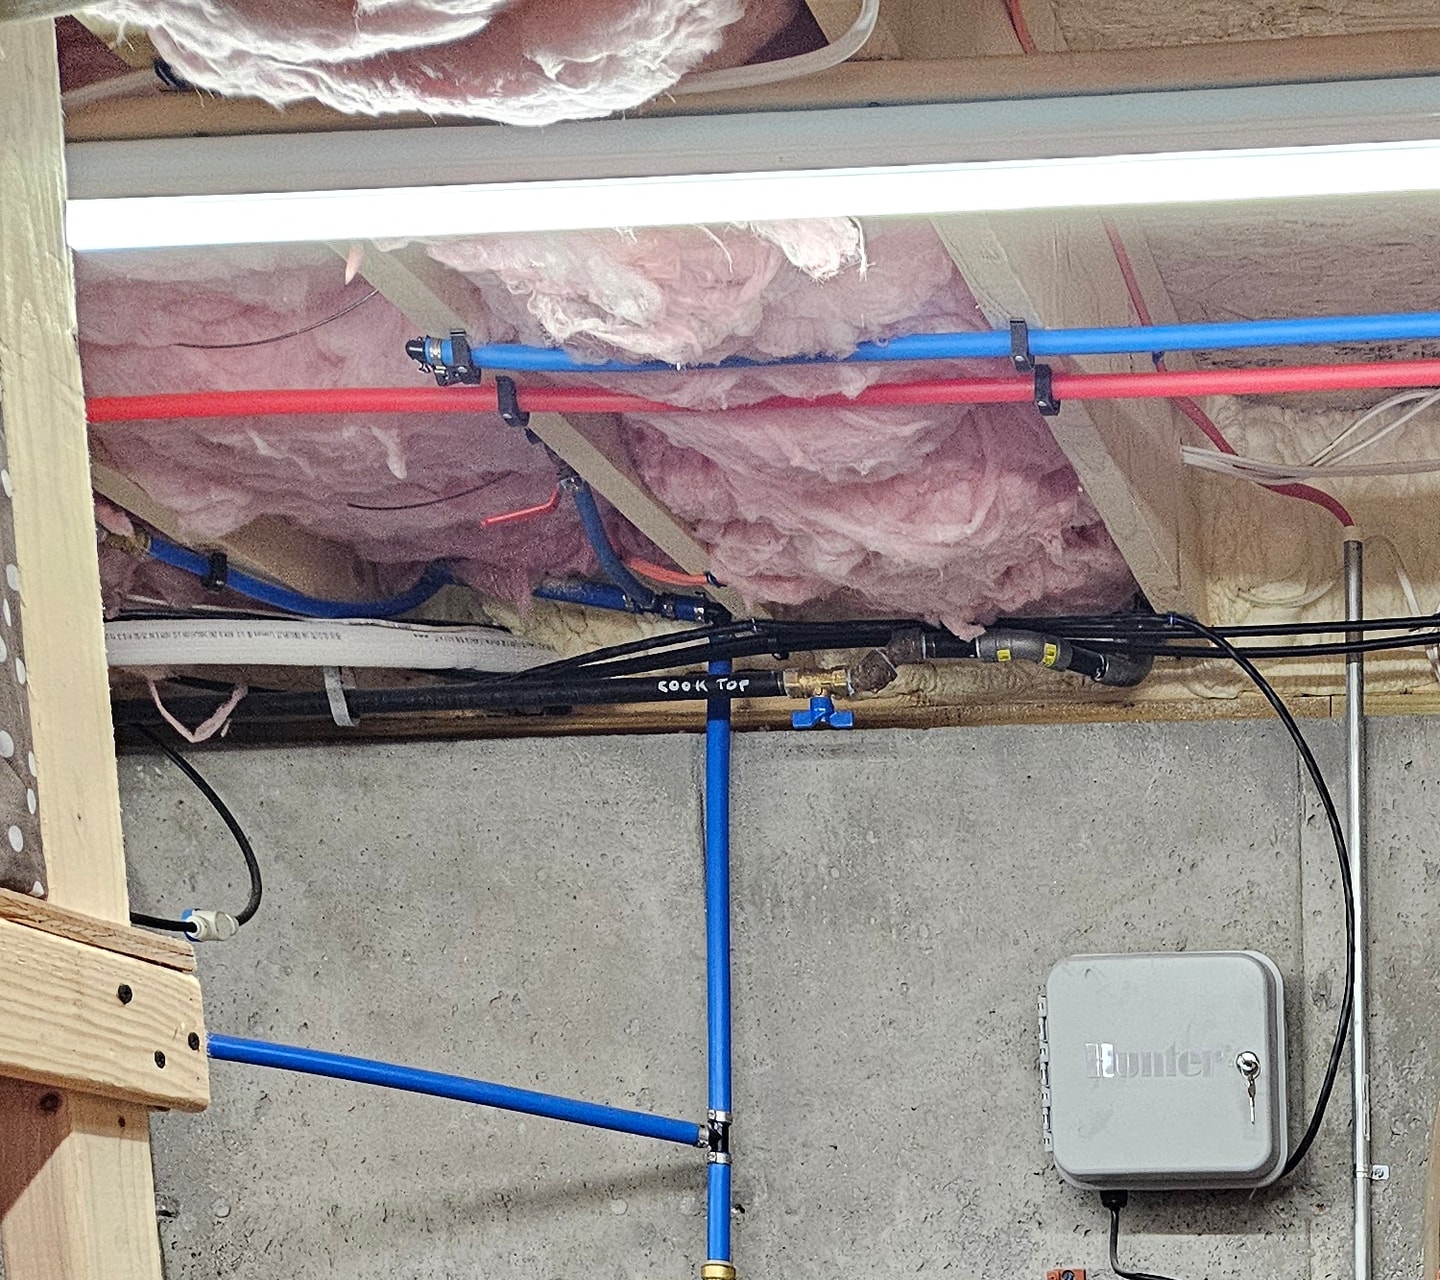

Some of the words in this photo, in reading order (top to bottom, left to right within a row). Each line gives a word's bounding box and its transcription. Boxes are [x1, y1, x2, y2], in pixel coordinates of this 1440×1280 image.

[657, 680, 708, 693] COOK
[716, 678, 750, 692] TOP
[1084, 1043, 1226, 1079] Hunter
